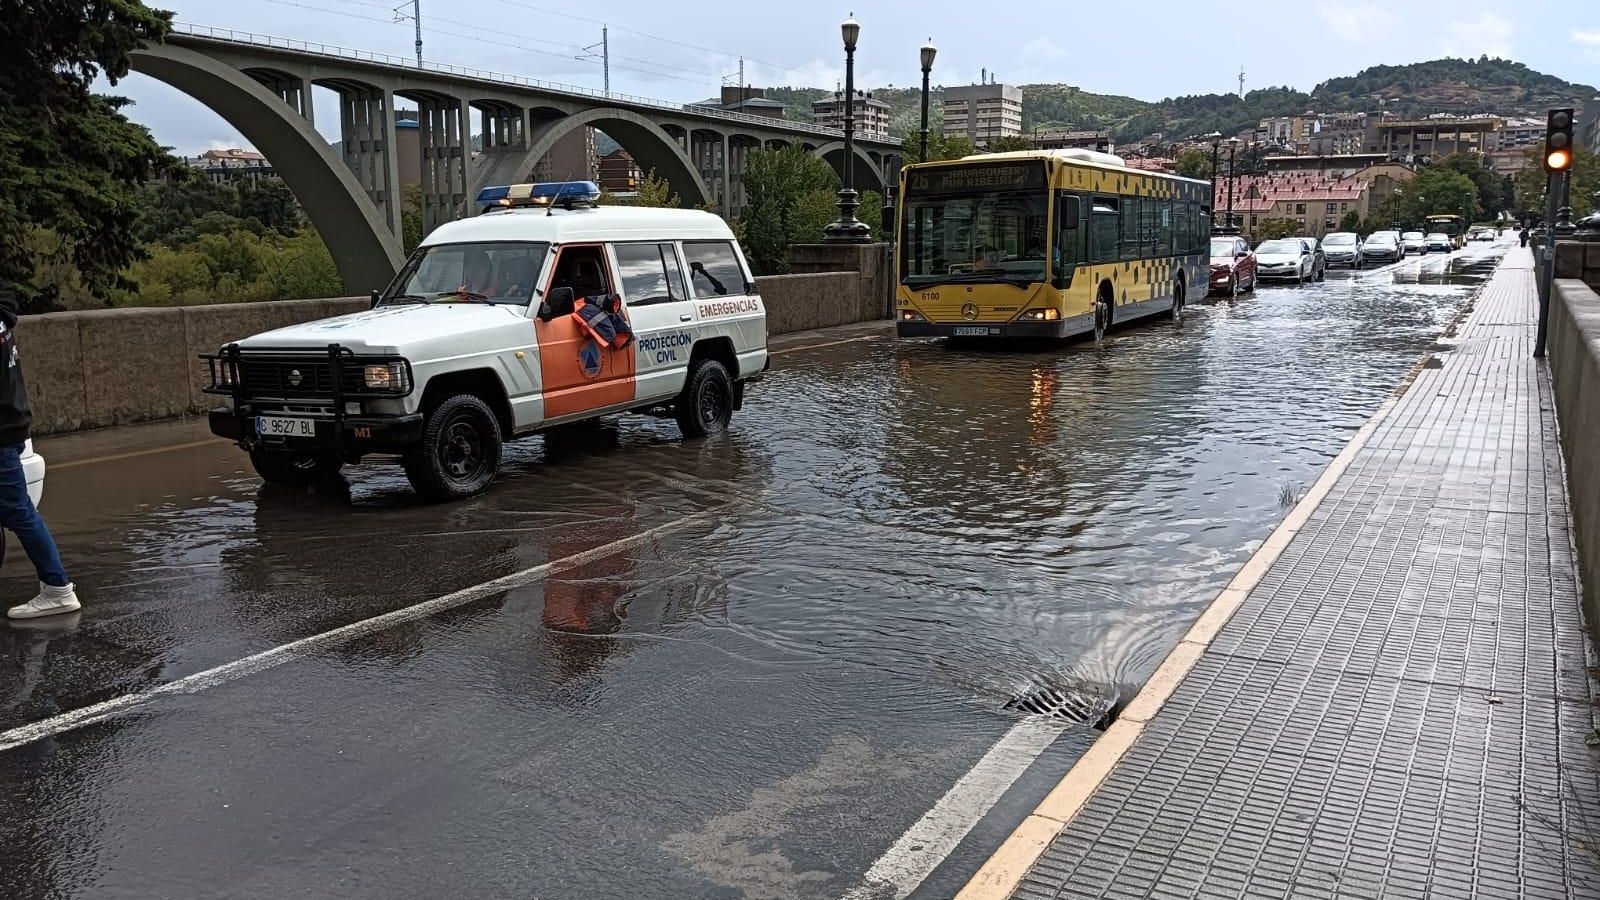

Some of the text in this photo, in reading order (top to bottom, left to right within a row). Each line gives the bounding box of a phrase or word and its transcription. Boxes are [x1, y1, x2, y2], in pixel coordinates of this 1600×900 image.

[921, 292, 940, 301] 6100
[699, 299, 758, 318] EMERGENCIAS
[639, 331, 692, 352] PROTECCIÓN
[656, 351, 677, 363] CIVIL
[260, 419, 314, 435] C 9627 BL
[354, 427, 372, 438] M1
